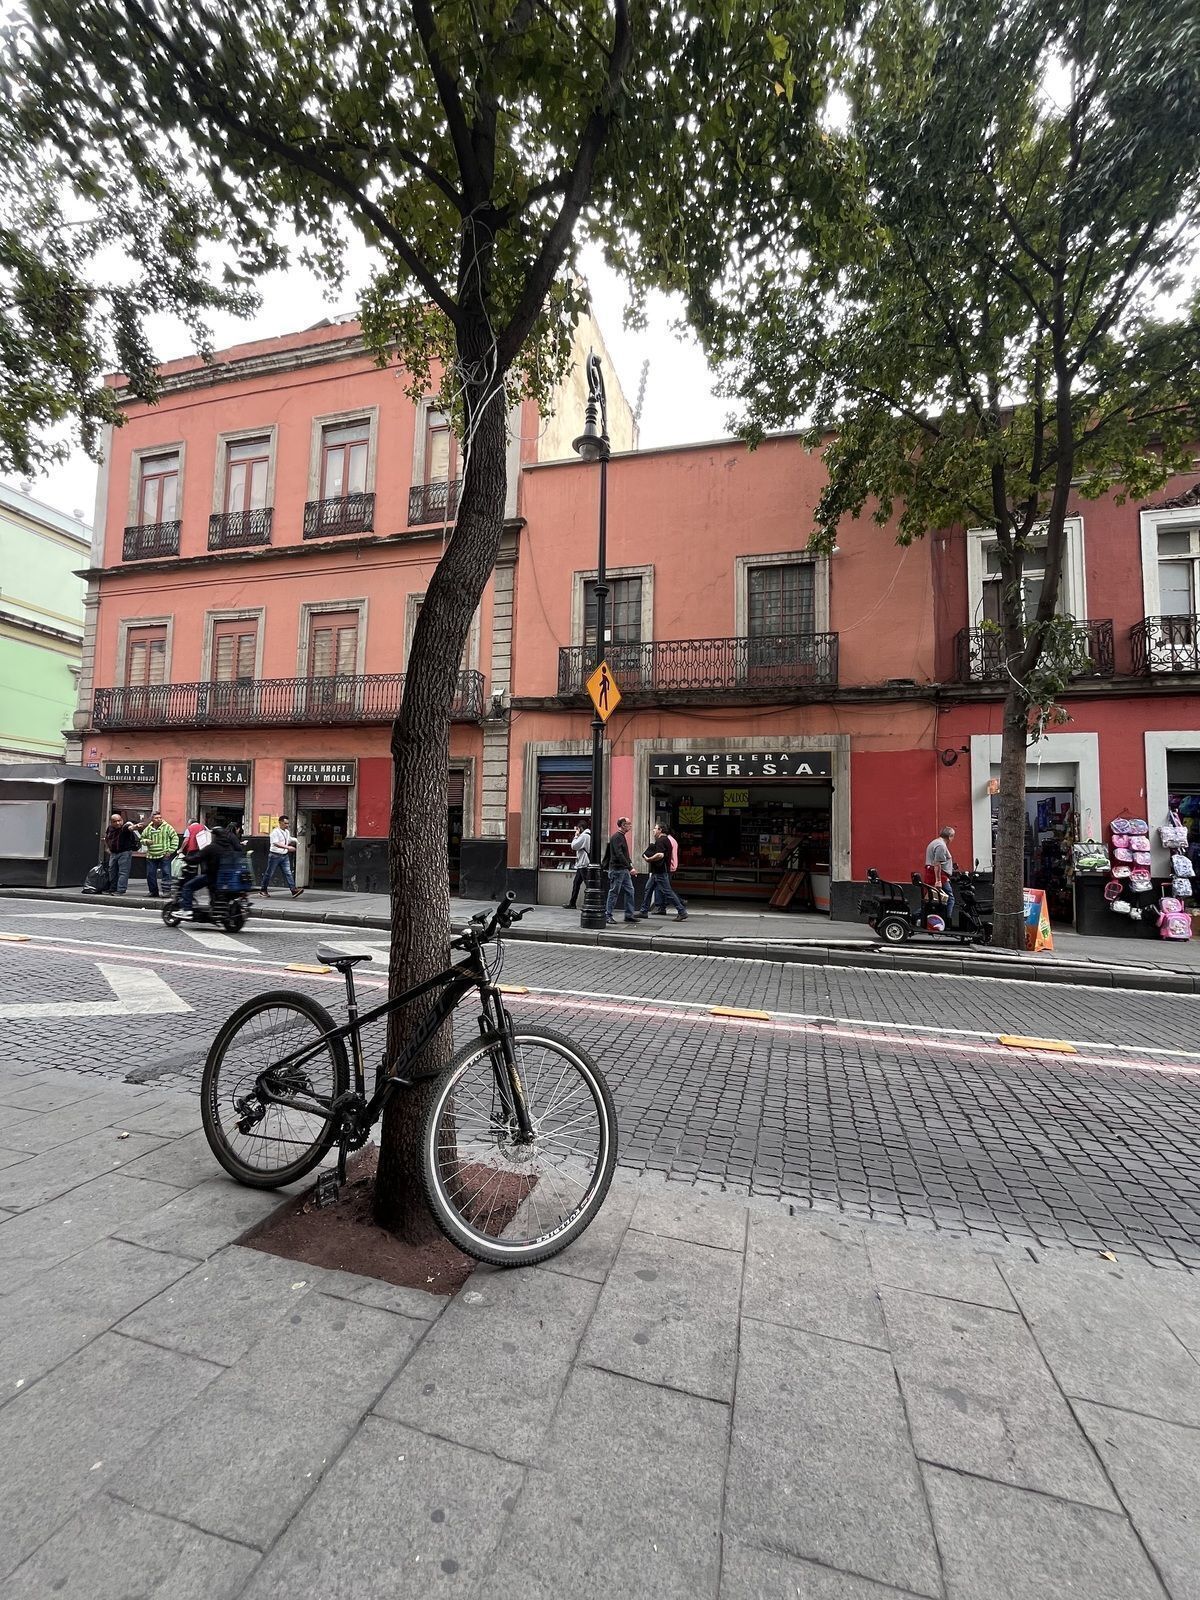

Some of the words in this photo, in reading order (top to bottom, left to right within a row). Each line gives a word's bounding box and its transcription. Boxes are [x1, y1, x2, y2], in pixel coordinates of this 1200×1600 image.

[685, 753, 790, 762] PAPELERA
[115, 764, 145, 774] ARTE
[293, 764, 318, 773] PAPEL
[320, 764, 347, 773] KRAFT
[287, 774, 312, 782] TRAZO
[314, 774, 320, 782] Y
[323, 774, 351, 782] MOLDE
